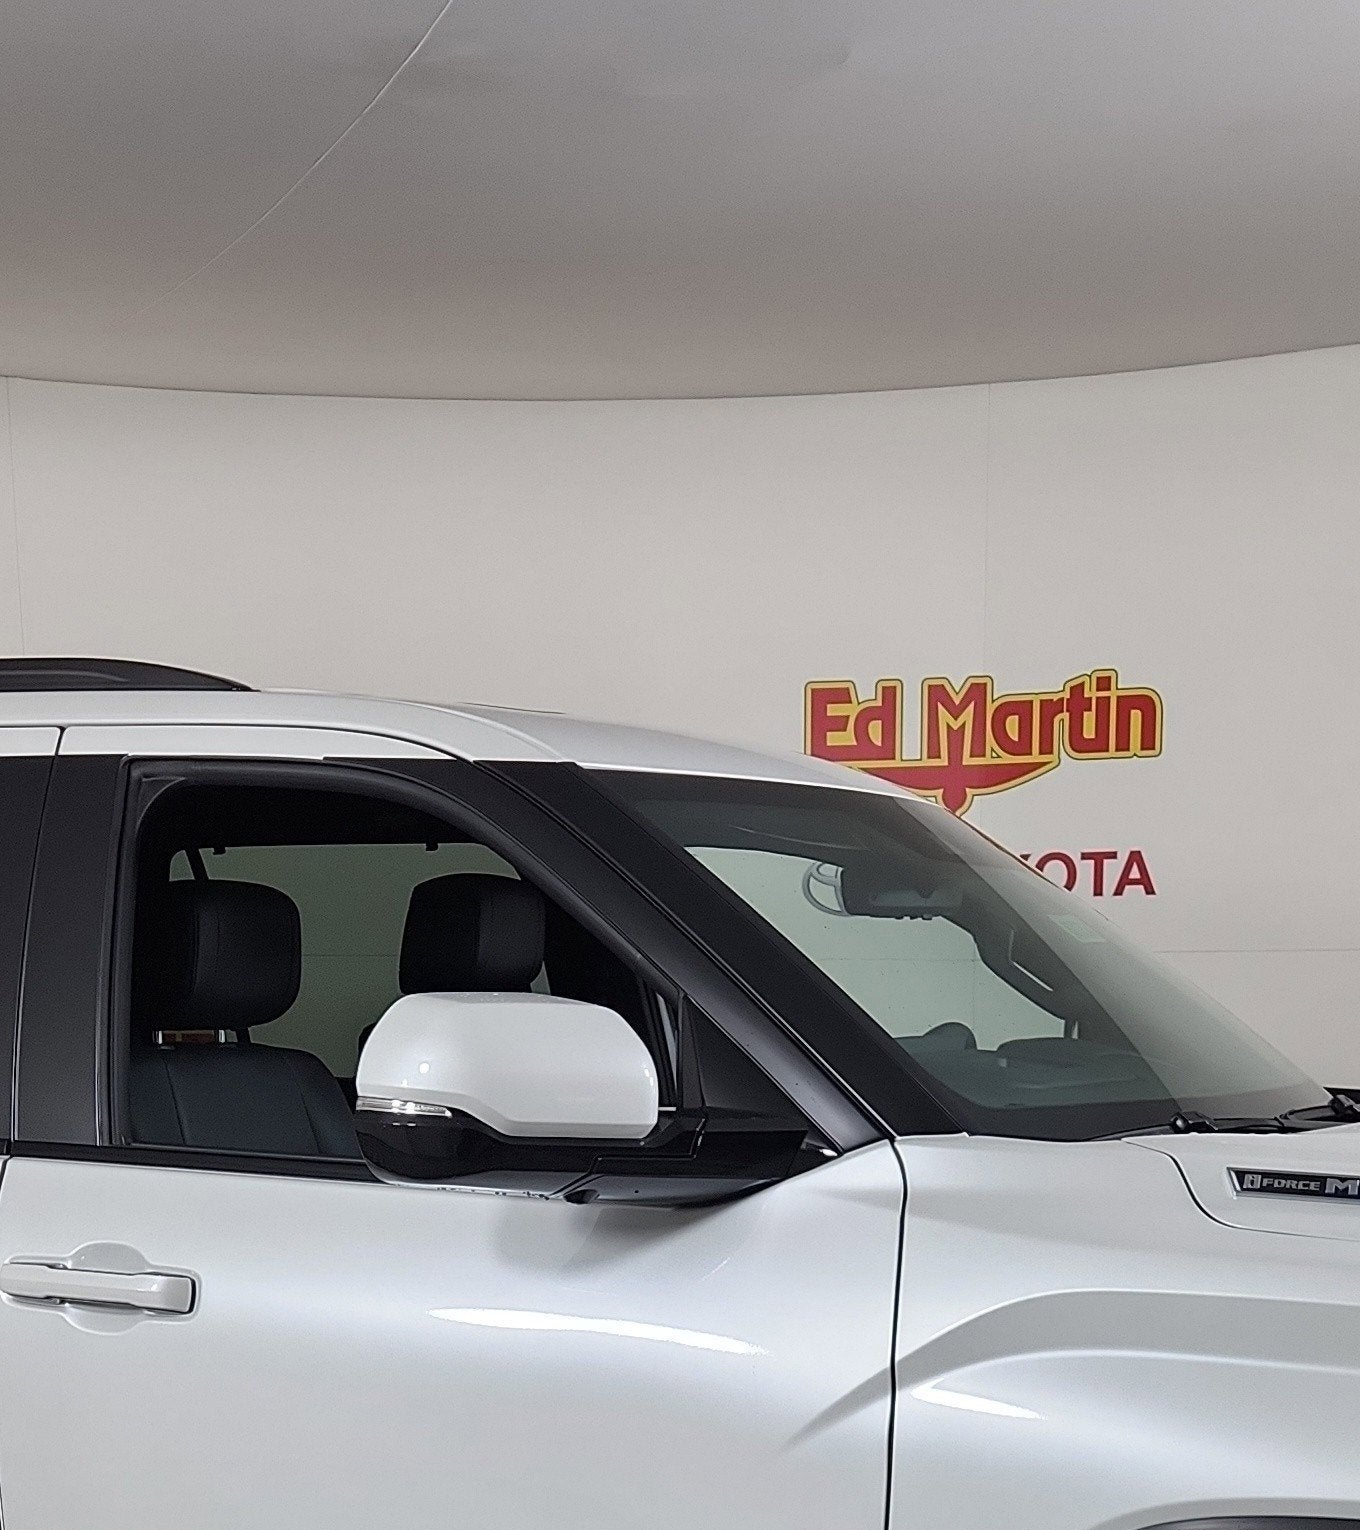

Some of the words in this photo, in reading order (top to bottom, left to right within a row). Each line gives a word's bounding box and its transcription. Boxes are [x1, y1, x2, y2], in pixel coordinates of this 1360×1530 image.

[808, 682, 899, 762] Ed
[924, 673, 1159, 761] Martin
[1020, 850, 1157, 897] OTA
